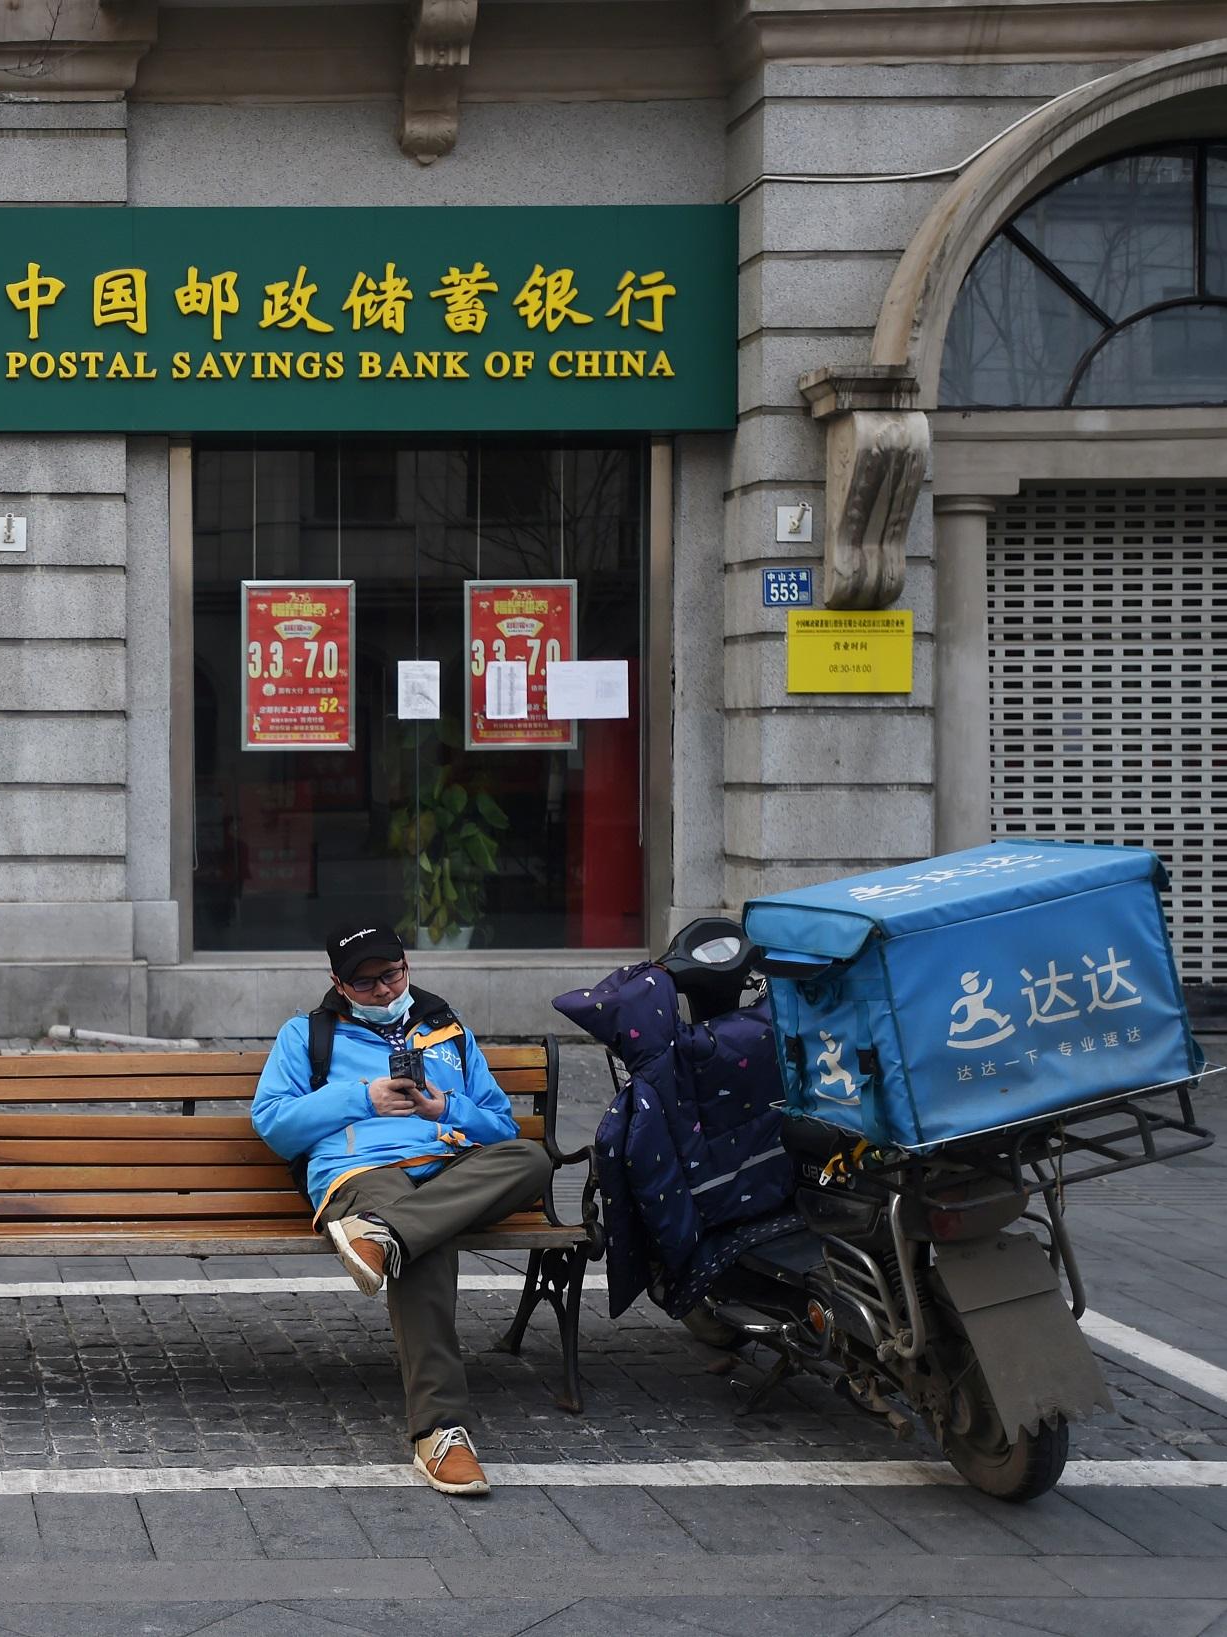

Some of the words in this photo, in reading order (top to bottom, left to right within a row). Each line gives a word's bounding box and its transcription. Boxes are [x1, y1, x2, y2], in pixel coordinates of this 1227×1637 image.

[5, 262, 676, 340] 中国邮政储蓄银行
[5, 350, 157, 379] POSTAL
[172, 350, 344, 379] SAVINGS
[359, 350, 469, 379] BANK
[484, 350, 535, 378] OF
[548, 350, 676, 379] CHINA
[770, 582, 799, 602] 553
[828, 664, 872, 673] 08:30-18:00
[340, 928, 377, 947] Champion
[1019, 947, 1142, 1028] 达达
[956, 1049, 1039, 1082] 达达一下
[1057, 1026, 1142, 1057] 专业速达
